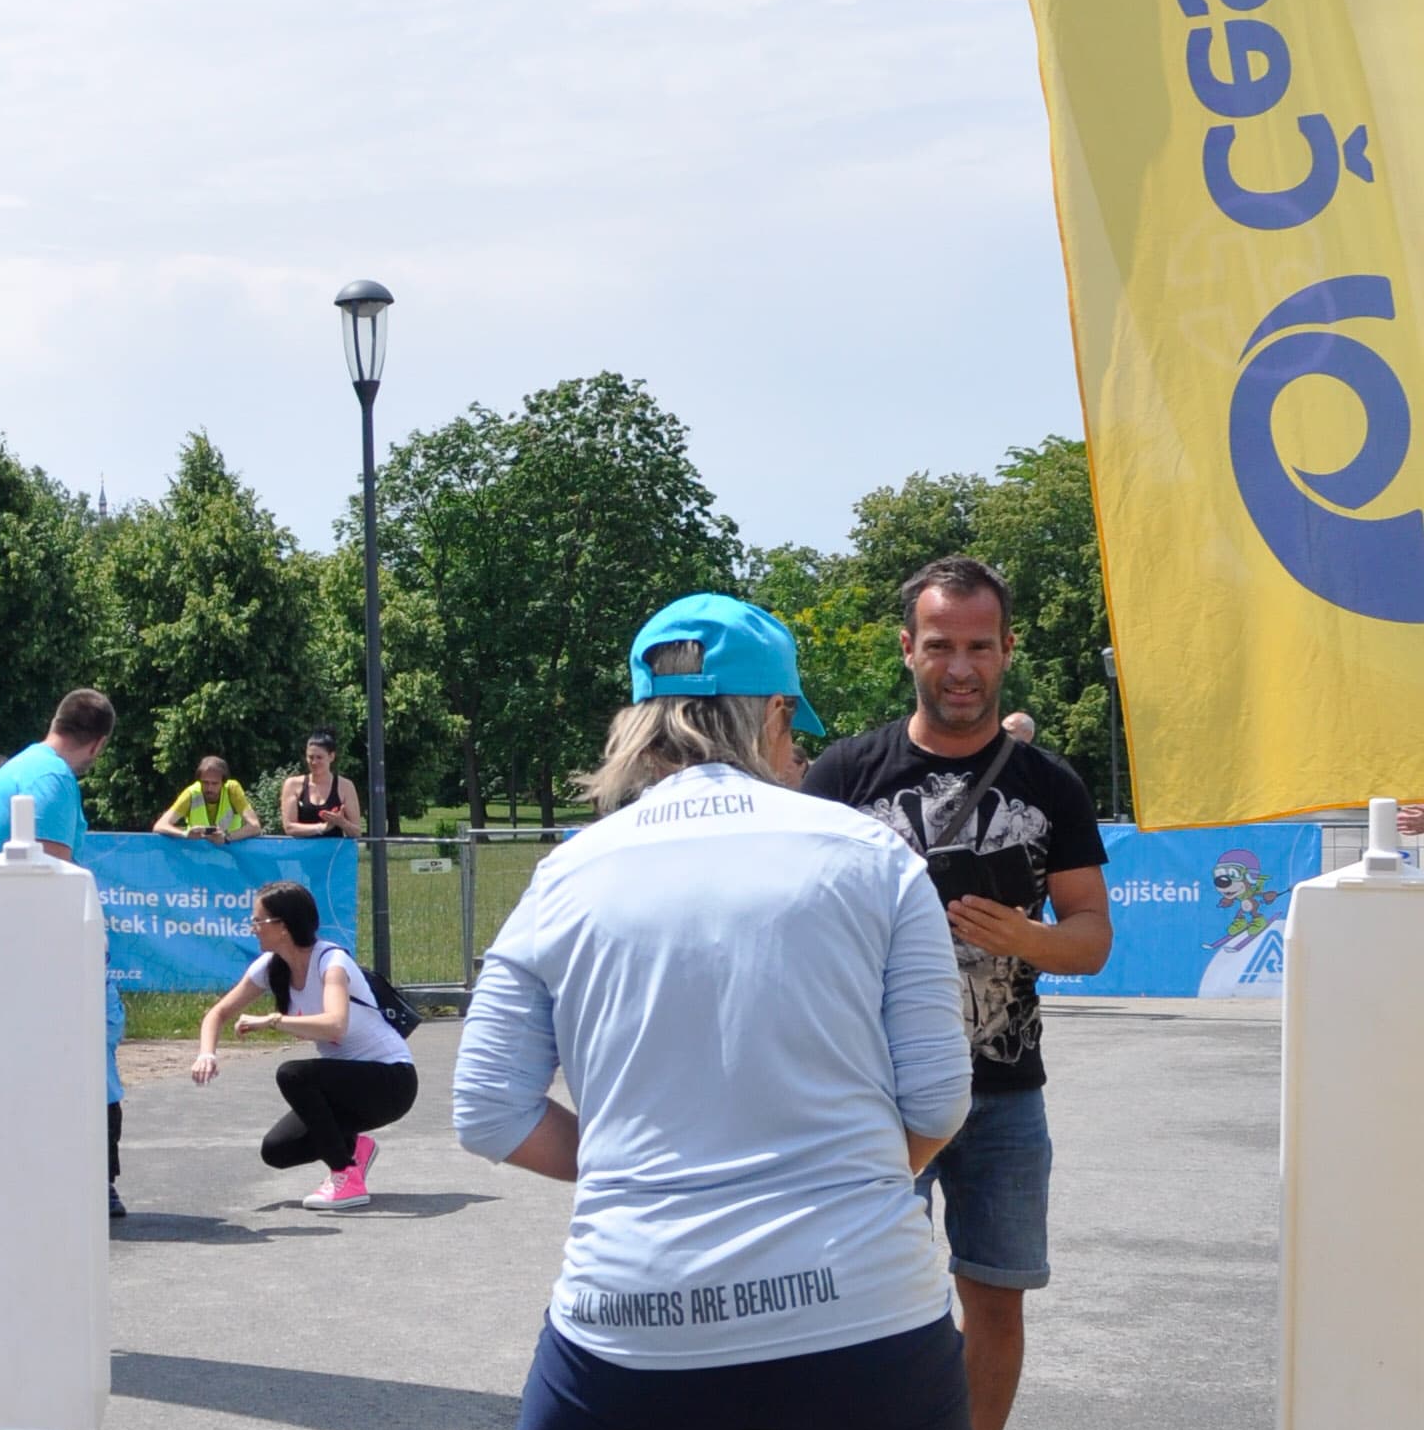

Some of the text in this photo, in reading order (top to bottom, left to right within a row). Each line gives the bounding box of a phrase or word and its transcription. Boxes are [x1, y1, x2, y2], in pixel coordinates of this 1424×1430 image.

[165, 887, 208, 908] vaši
[1110, 880, 1201, 906] ojištění
[151, 914, 158, 934] i
[598, 1291, 684, 1327] RUNNERS
[690, 1285, 730, 1324] ARE
[733, 1266, 841, 1318] BEAUTIFUL
